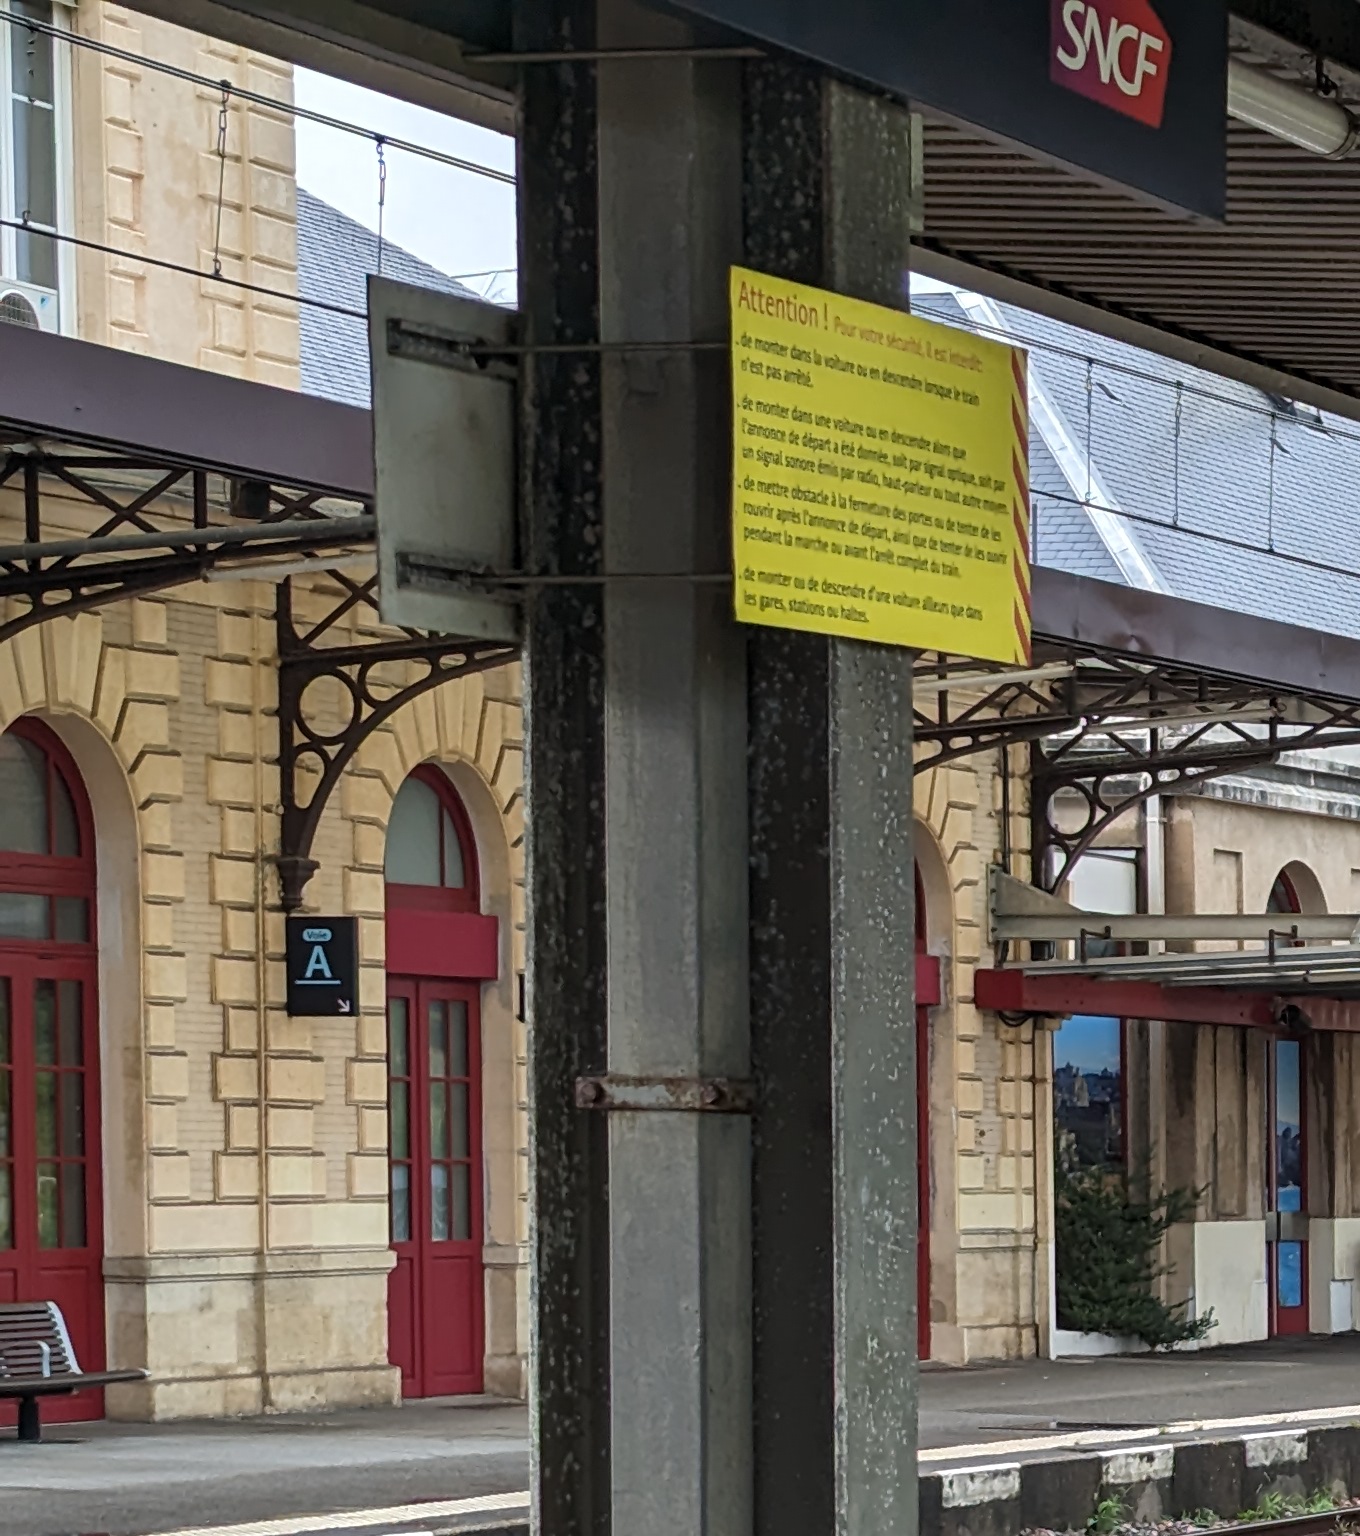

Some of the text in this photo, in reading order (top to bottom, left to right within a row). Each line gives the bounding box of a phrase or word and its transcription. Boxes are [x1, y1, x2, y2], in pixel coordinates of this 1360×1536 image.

[1057, 0, 1163, 96] SNCF
[738, 281, 819, 328] Attention
[741, 332, 753, 348] de
[742, 394, 753, 411] de
[743, 475, 755, 492] de
[743, 566, 755, 582] de
[304, 945, 333, 979] A
